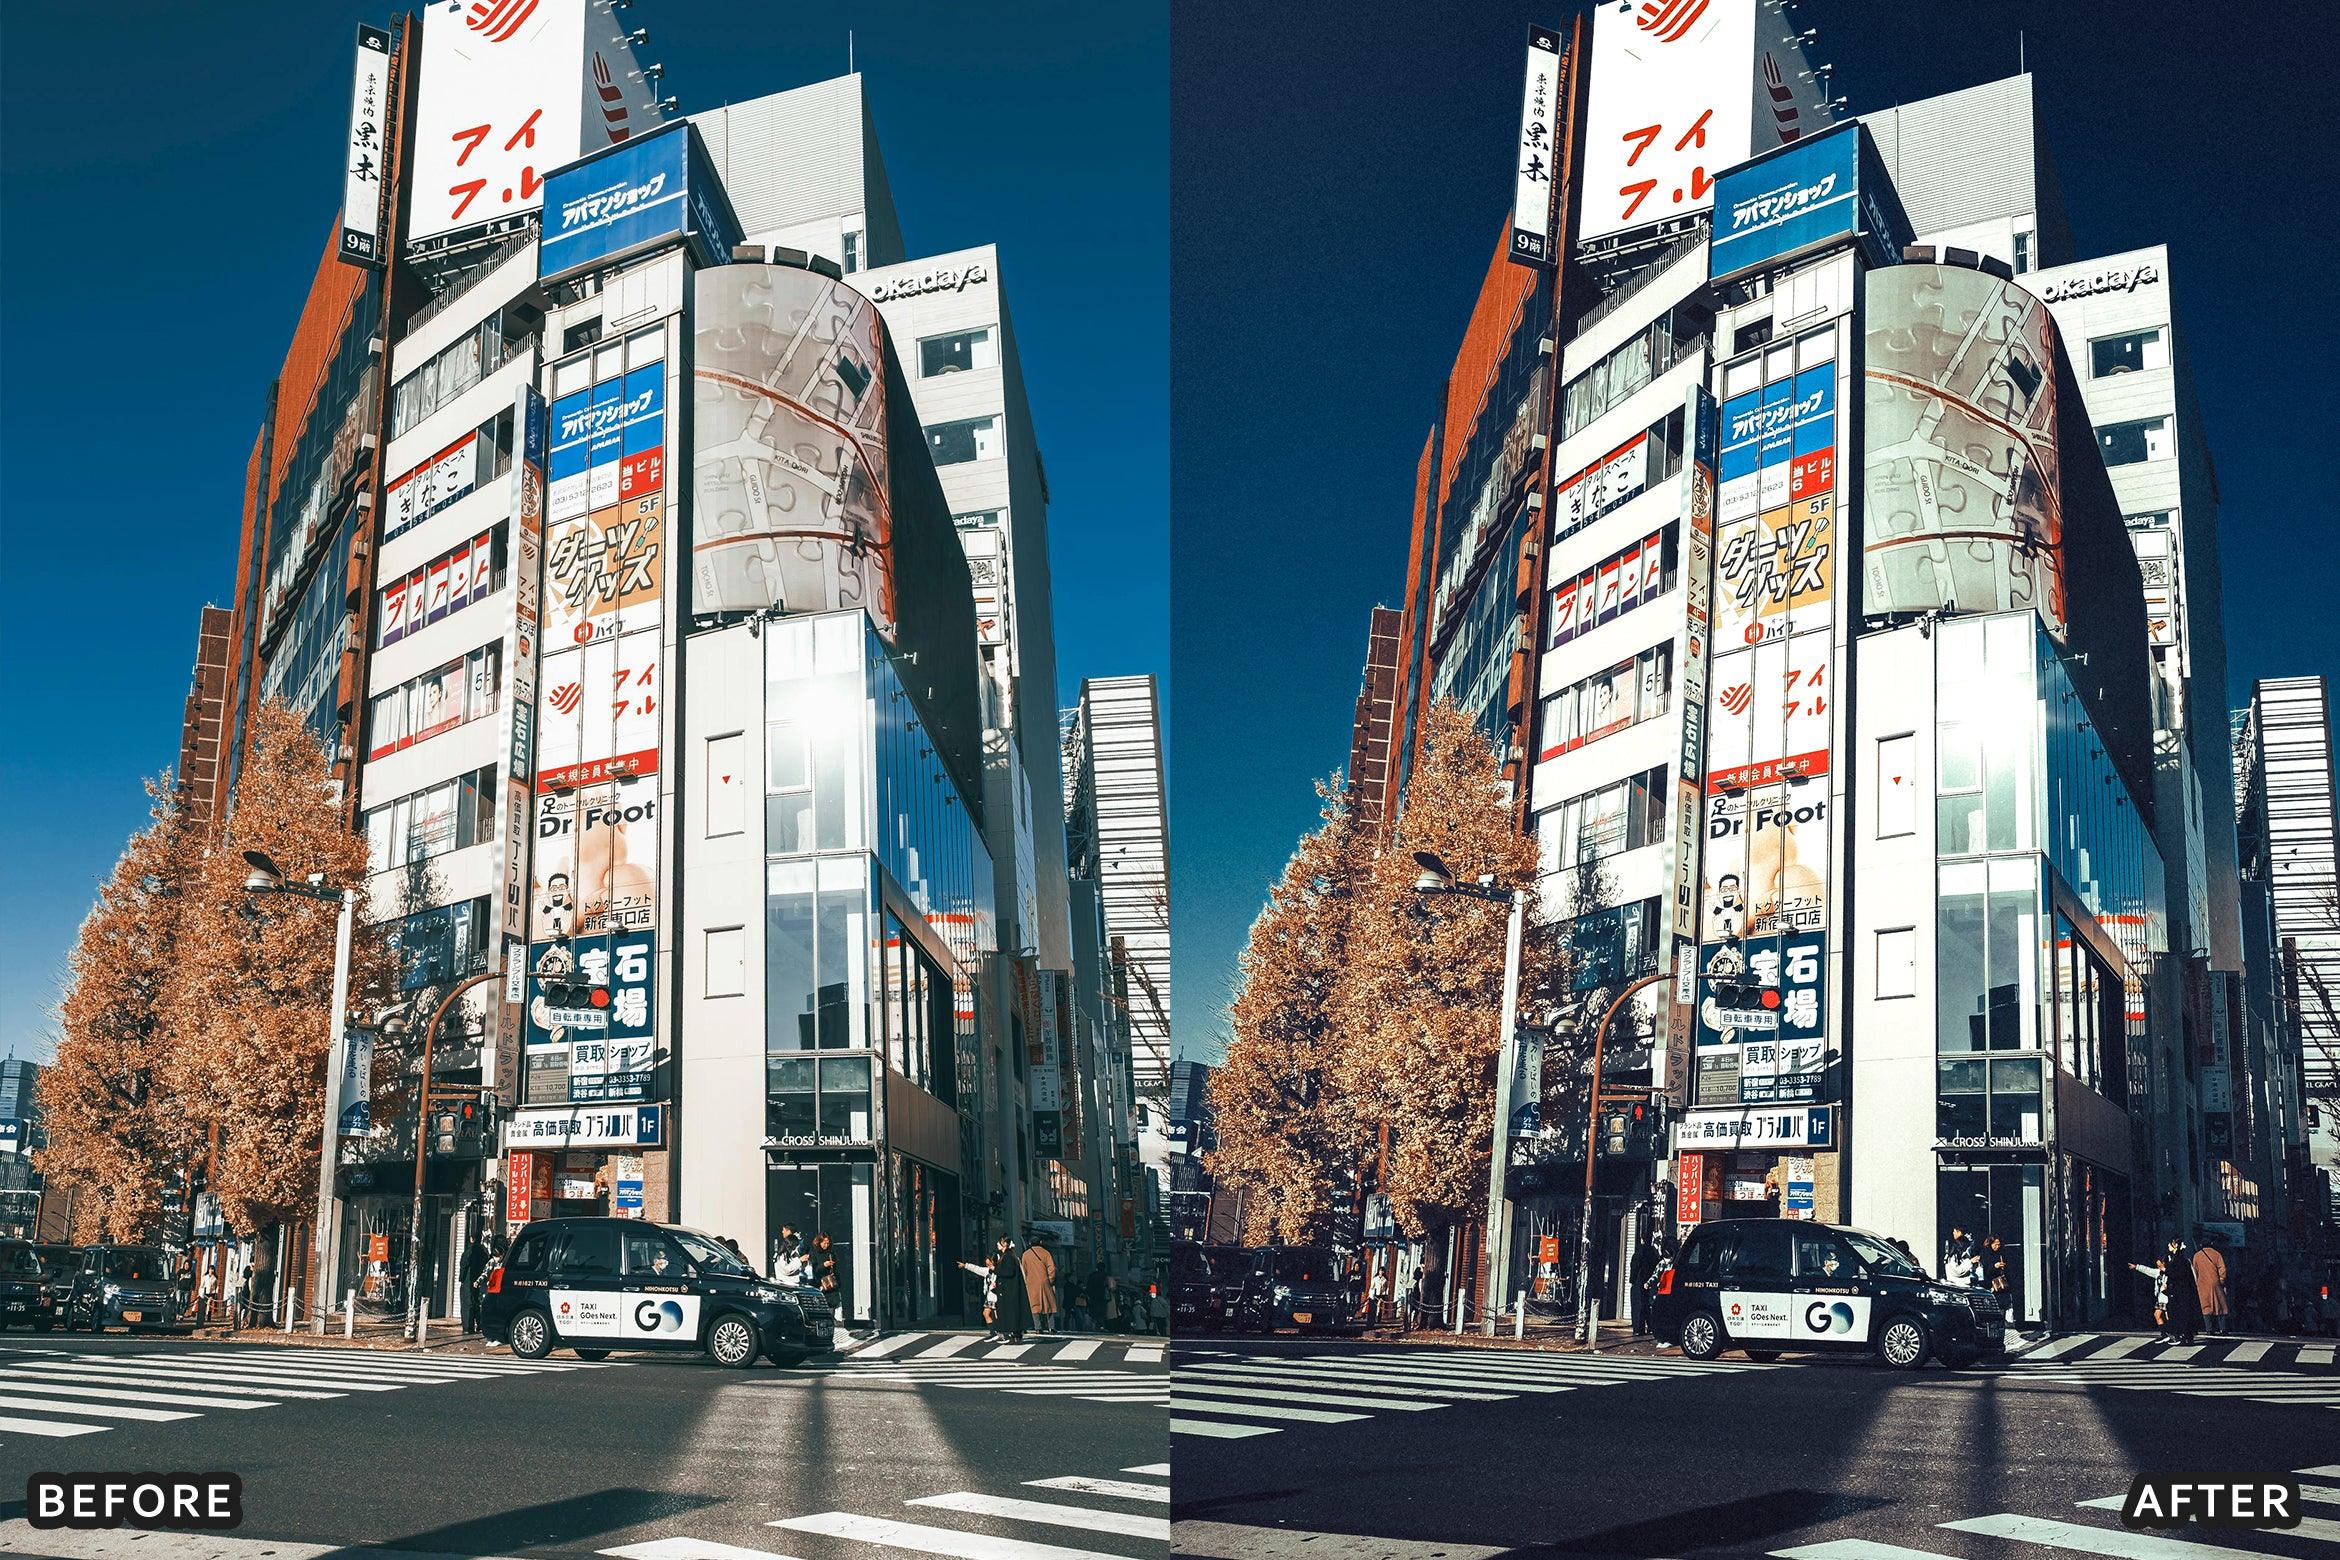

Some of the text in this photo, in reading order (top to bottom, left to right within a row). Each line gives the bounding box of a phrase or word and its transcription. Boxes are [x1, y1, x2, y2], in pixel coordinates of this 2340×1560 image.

[350, 121, 379, 182] 黒木
[452, 109, 542, 166] アイ
[1521, 121, 1550, 182] 黒木
[1623, 109, 1713, 166] アイ
[449, 166, 544, 220] フル
[562, 173, 666, 229] アパマンショップ
[1620, 166, 1715, 220] フル
[1733, 173, 1837, 229] アパマンショップ
[871, 259, 988, 302] okadaya
[2042, 259, 2159, 302] okadaya
[561, 389, 653, 439] アパマンショップ
[1732, 389, 1824, 439] アパマンショップ
[398, 449, 465, 499] レンタルスペース
[623, 456, 661, 477] 当ビル
[1569, 449, 1636, 499] レンタルスペース
[1794, 456, 1832, 477] 当ビル
[400, 470, 458, 522] きなこ
[640, 496, 659, 514] 5F
[1571, 470, 1629, 522] きなこ
[1811, 497, 1830, 515] 5F
[953, 515, 984, 527] adaya
[2124, 516, 2155, 528] adaya
[550, 518, 641, 579] ダーツ
[1721, 519, 1812, 580] ダーツ
[384, 559, 489, 631] ブリアント
[566, 543, 658, 607] グッズ
[1555, 560, 1660, 632] ブリアント
[1737, 544, 1829, 608] グッズ
[612, 663, 655, 692] アイ
[1783, 664, 1826, 693] アイ
[611, 695, 656, 722] フル
[1782, 696, 1827, 723] フル
[513, 703, 528, 779] 宝石広場
[1684, 704, 1699, 780] 宝石広場
[539, 800, 655, 838] Dr Foot
[1710, 801, 1826, 839] Dr Foot
[552, 1012, 604, 1025] 自転車専用
[1723, 1013, 1775, 1026] 自転車専用
[498, 1001, 516, 1105] ールドラッシュ
[575, 1042, 651, 1064] 買取ショップ
[1669, 1002, 1687, 1106] ールドラッシュ
[1746, 1043, 1822, 1065] 買取ショップ
[533, 1120, 582, 1137] 高価買取
[641, 1116, 655, 1133] 1F
[781, 1135, 869, 1147] CROSS SHINJUKU
[1704, 1121, 1753, 1138] 高価買取
[1812, 1117, 1826, 1134] 1F
[1952, 1136, 2040, 1148] CROSS SHINJUKU
[580, 1312, 598, 1320] GOes
[1751, 1313, 1769, 1321] GOes
